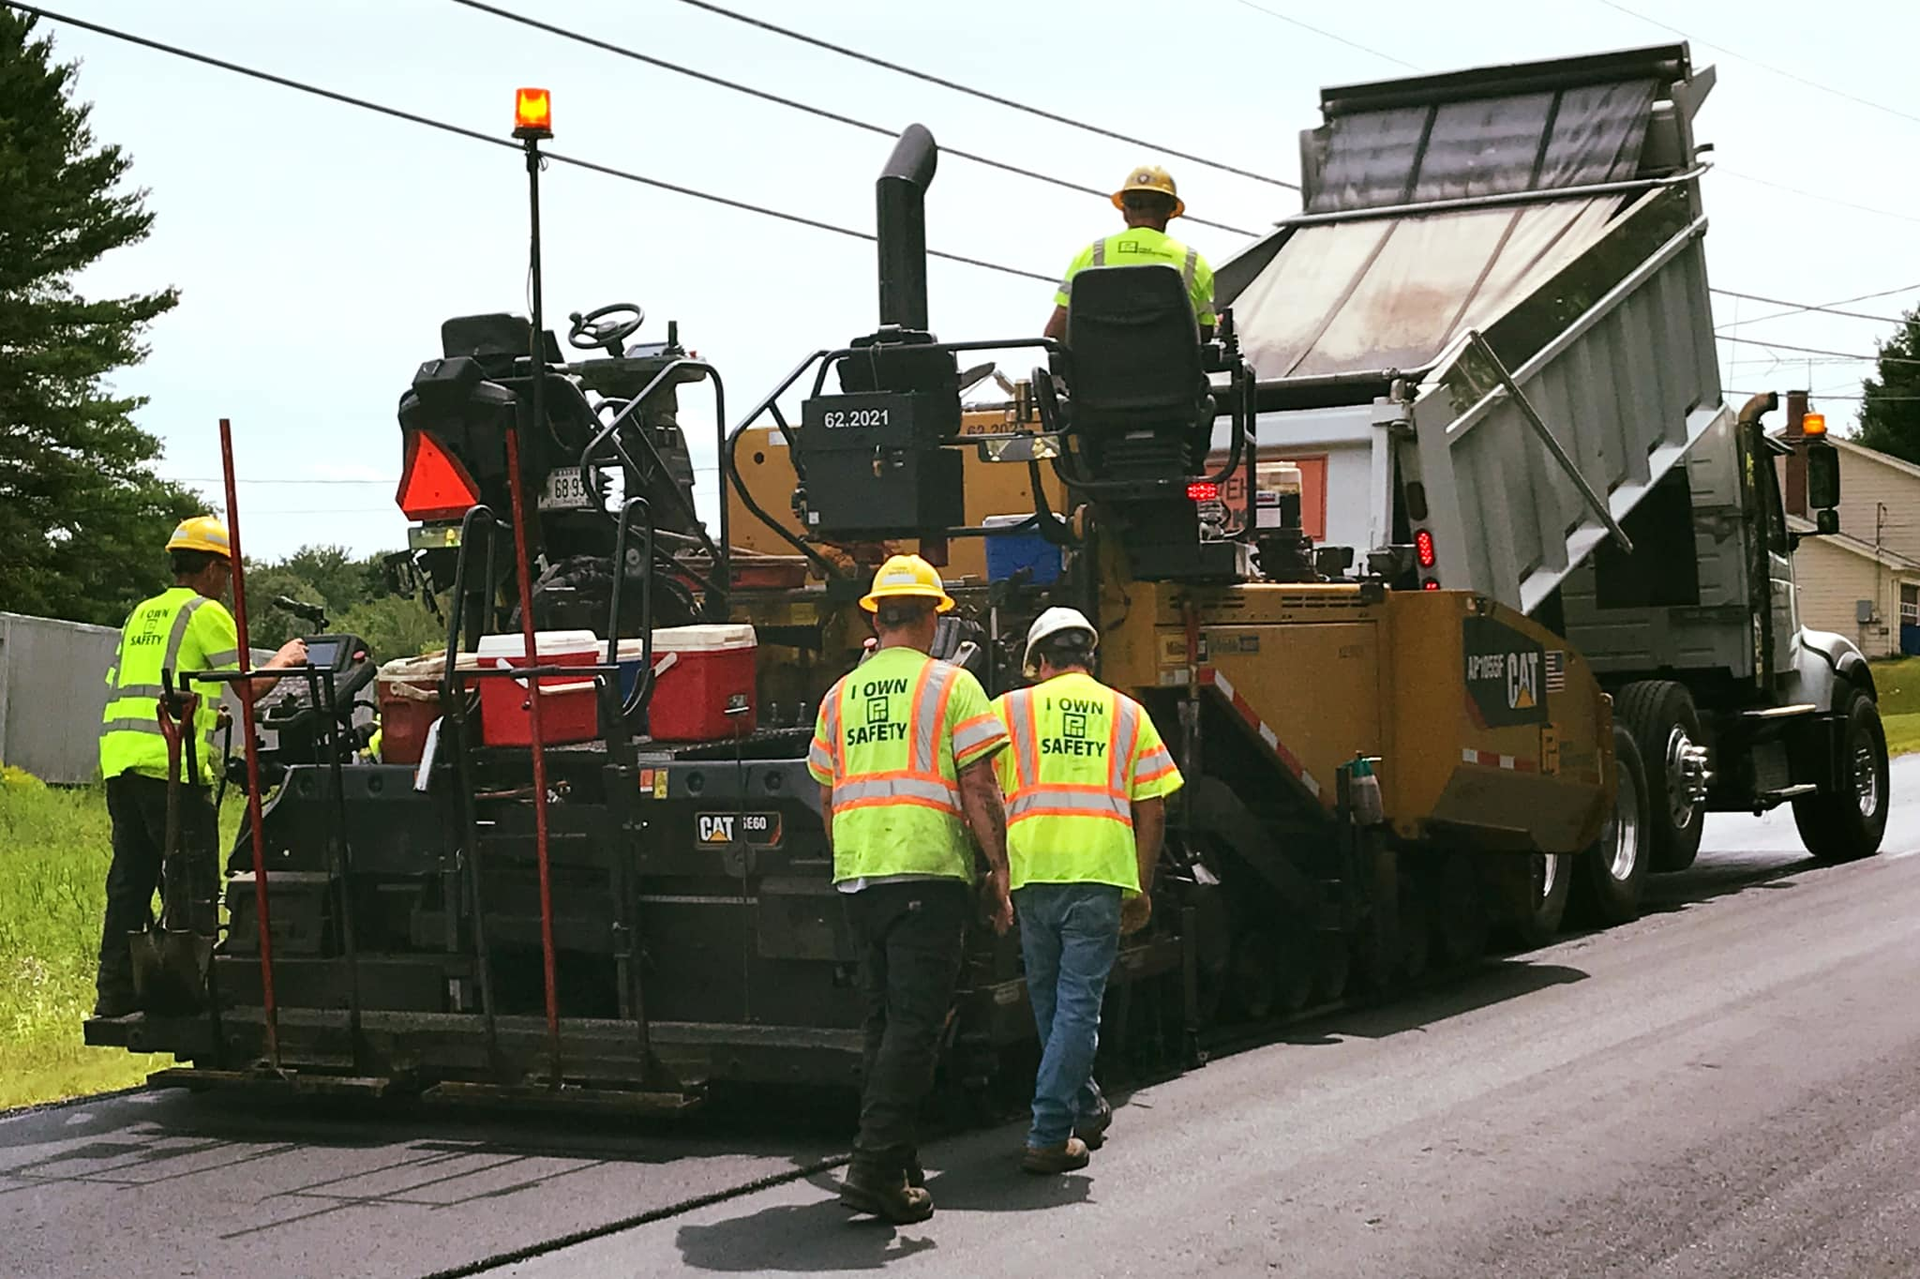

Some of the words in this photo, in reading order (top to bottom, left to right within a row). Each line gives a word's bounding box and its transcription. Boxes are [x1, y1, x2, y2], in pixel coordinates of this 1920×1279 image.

[824, 409, 890, 428] 62.2021
[147, 608, 170, 619] OWN
[130, 634, 164, 646] SAFETY
[851, 685, 857, 700] I
[863, 678, 908, 697] OWN
[1507, 652, 1539, 709] CAT
[1046, 697, 1051, 711] I
[1058, 697, 1104, 715] OWN
[847, 722, 907, 746] SAFETY
[1041, 738, 1106, 757] SAFETY
[699, 816, 735, 842] CAT
